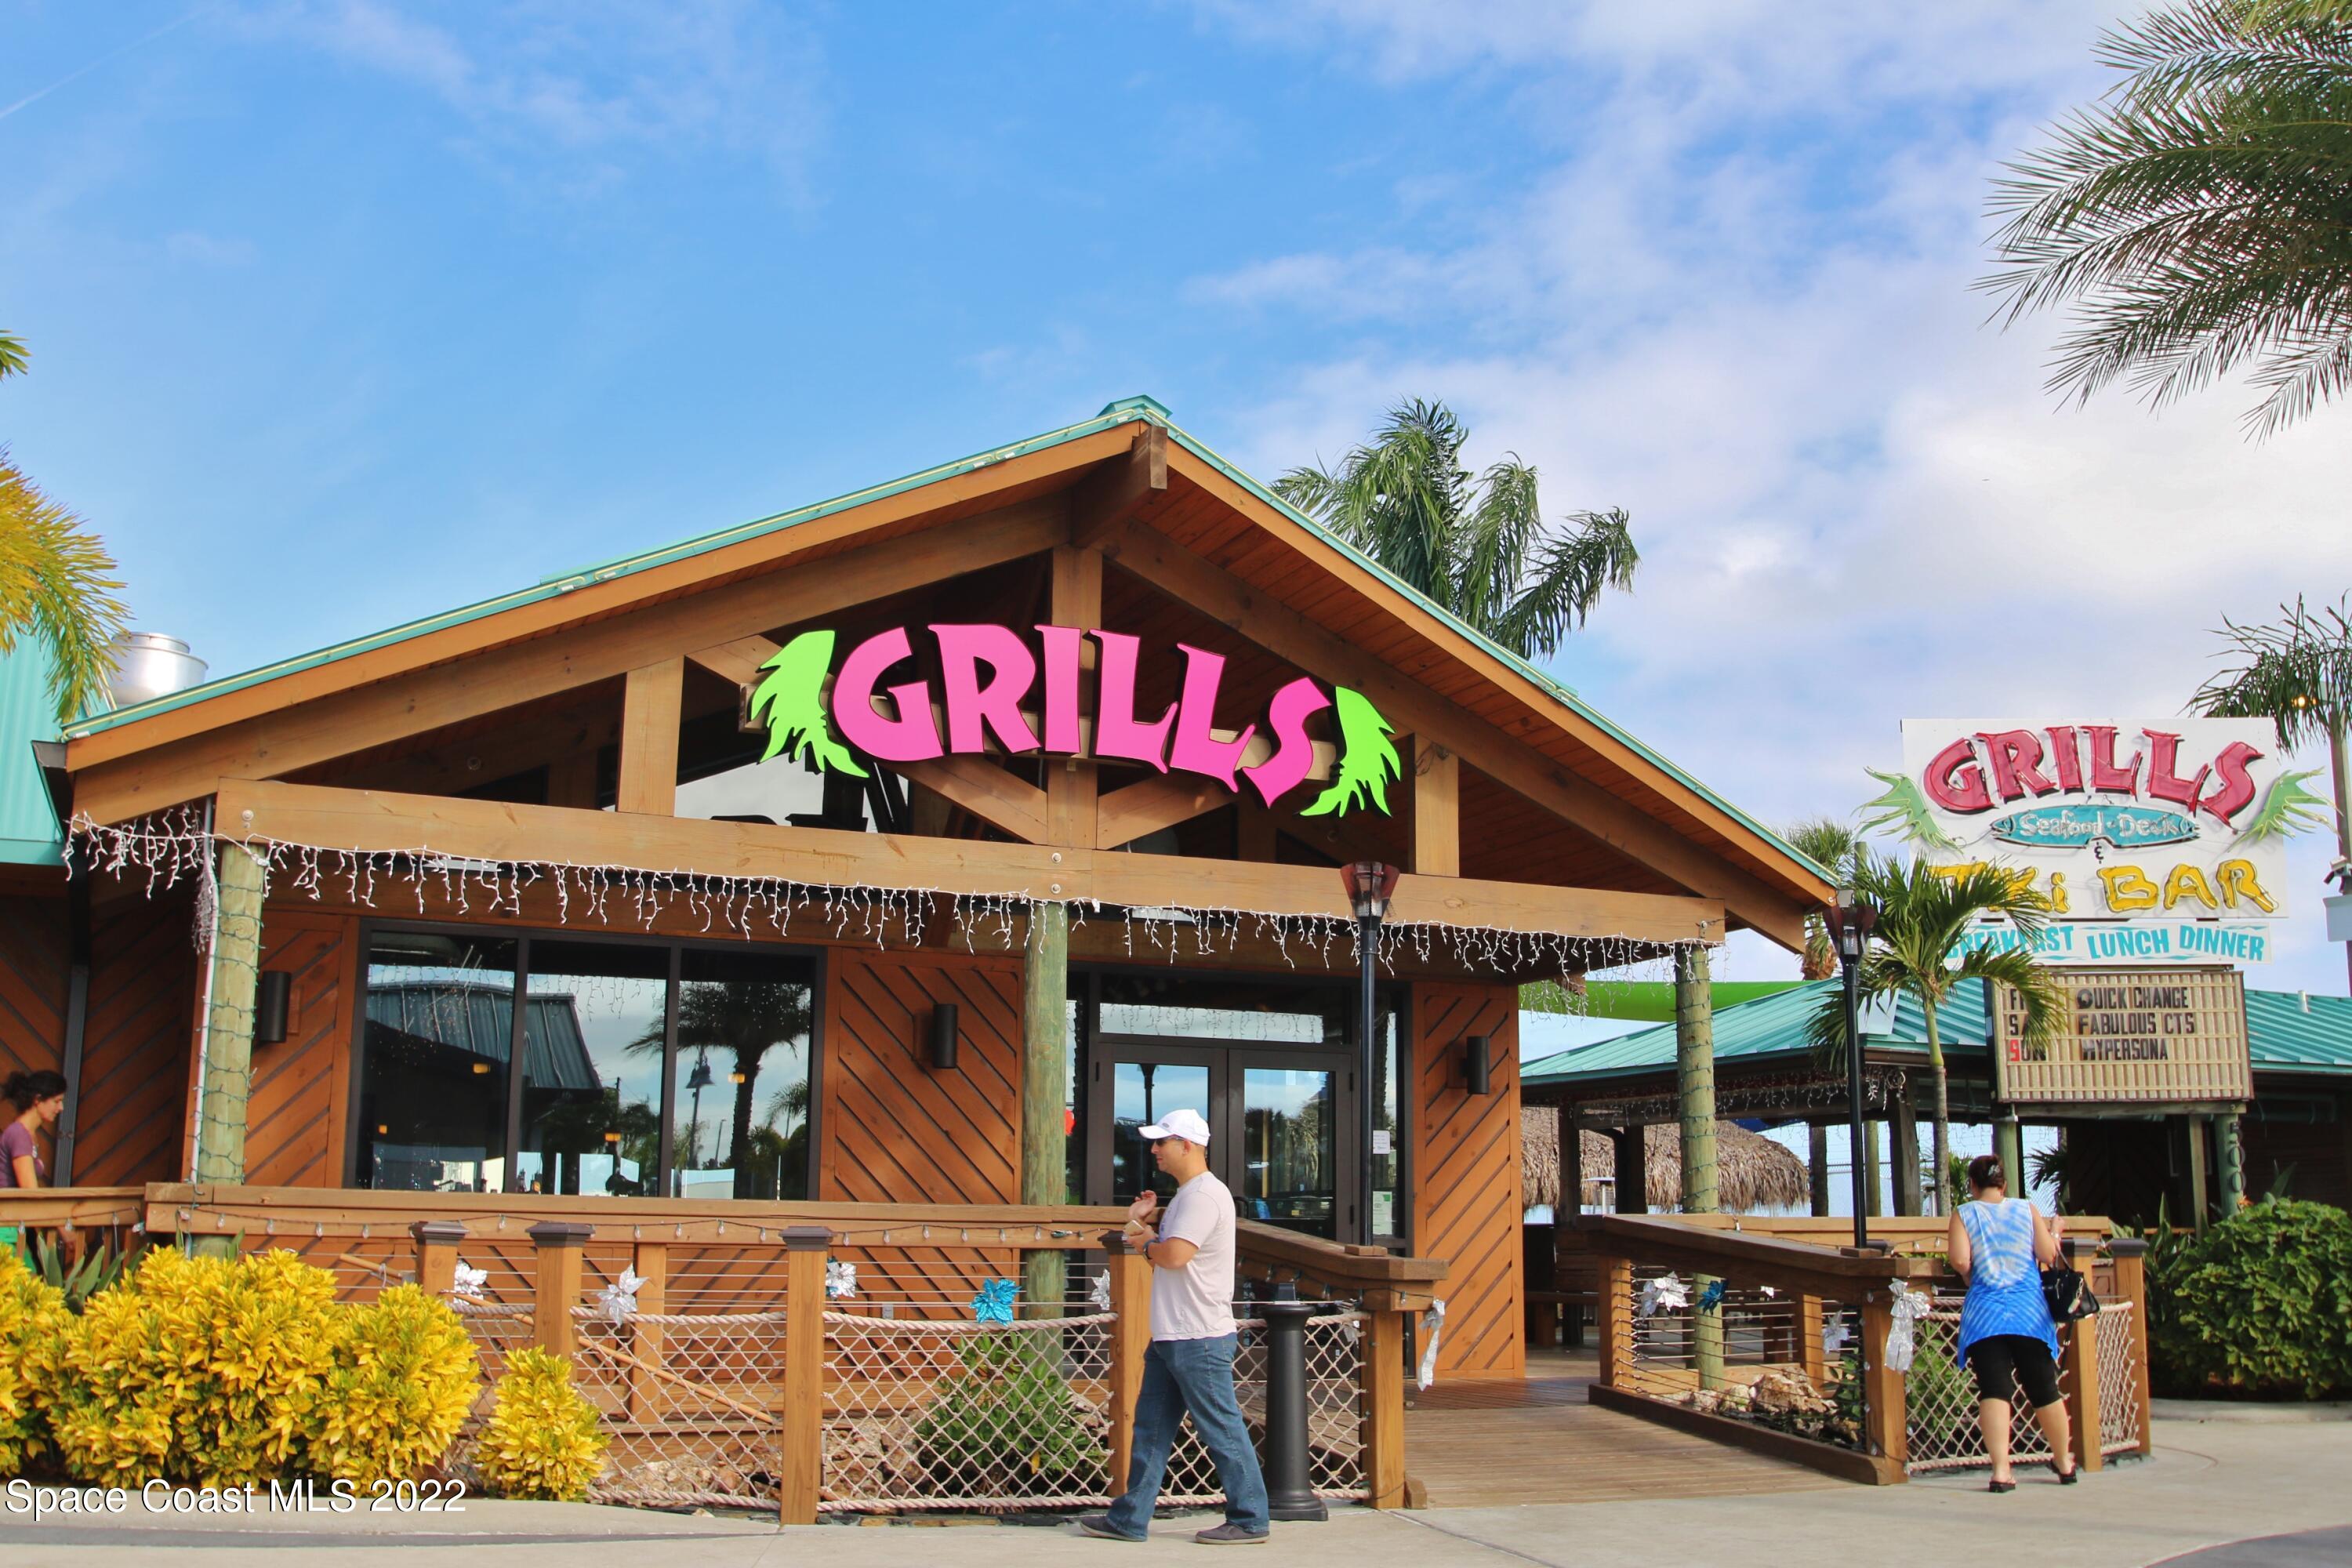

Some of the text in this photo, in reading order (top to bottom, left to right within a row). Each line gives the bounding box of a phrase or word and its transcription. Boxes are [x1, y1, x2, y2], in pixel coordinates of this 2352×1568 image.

[833, 624, 1333, 809] GRILLS
[1923, 725, 2264, 826] GRILLS
[2096, 859, 2281, 913] BAR
[2086, 928, 2170, 960] LUNCH
[2179, 924, 2265, 961] DINNER
[2077, 986, 2189, 1010] QUICK CHANGE
[2078, 1012, 2195, 1036] FABULOUS CTS
